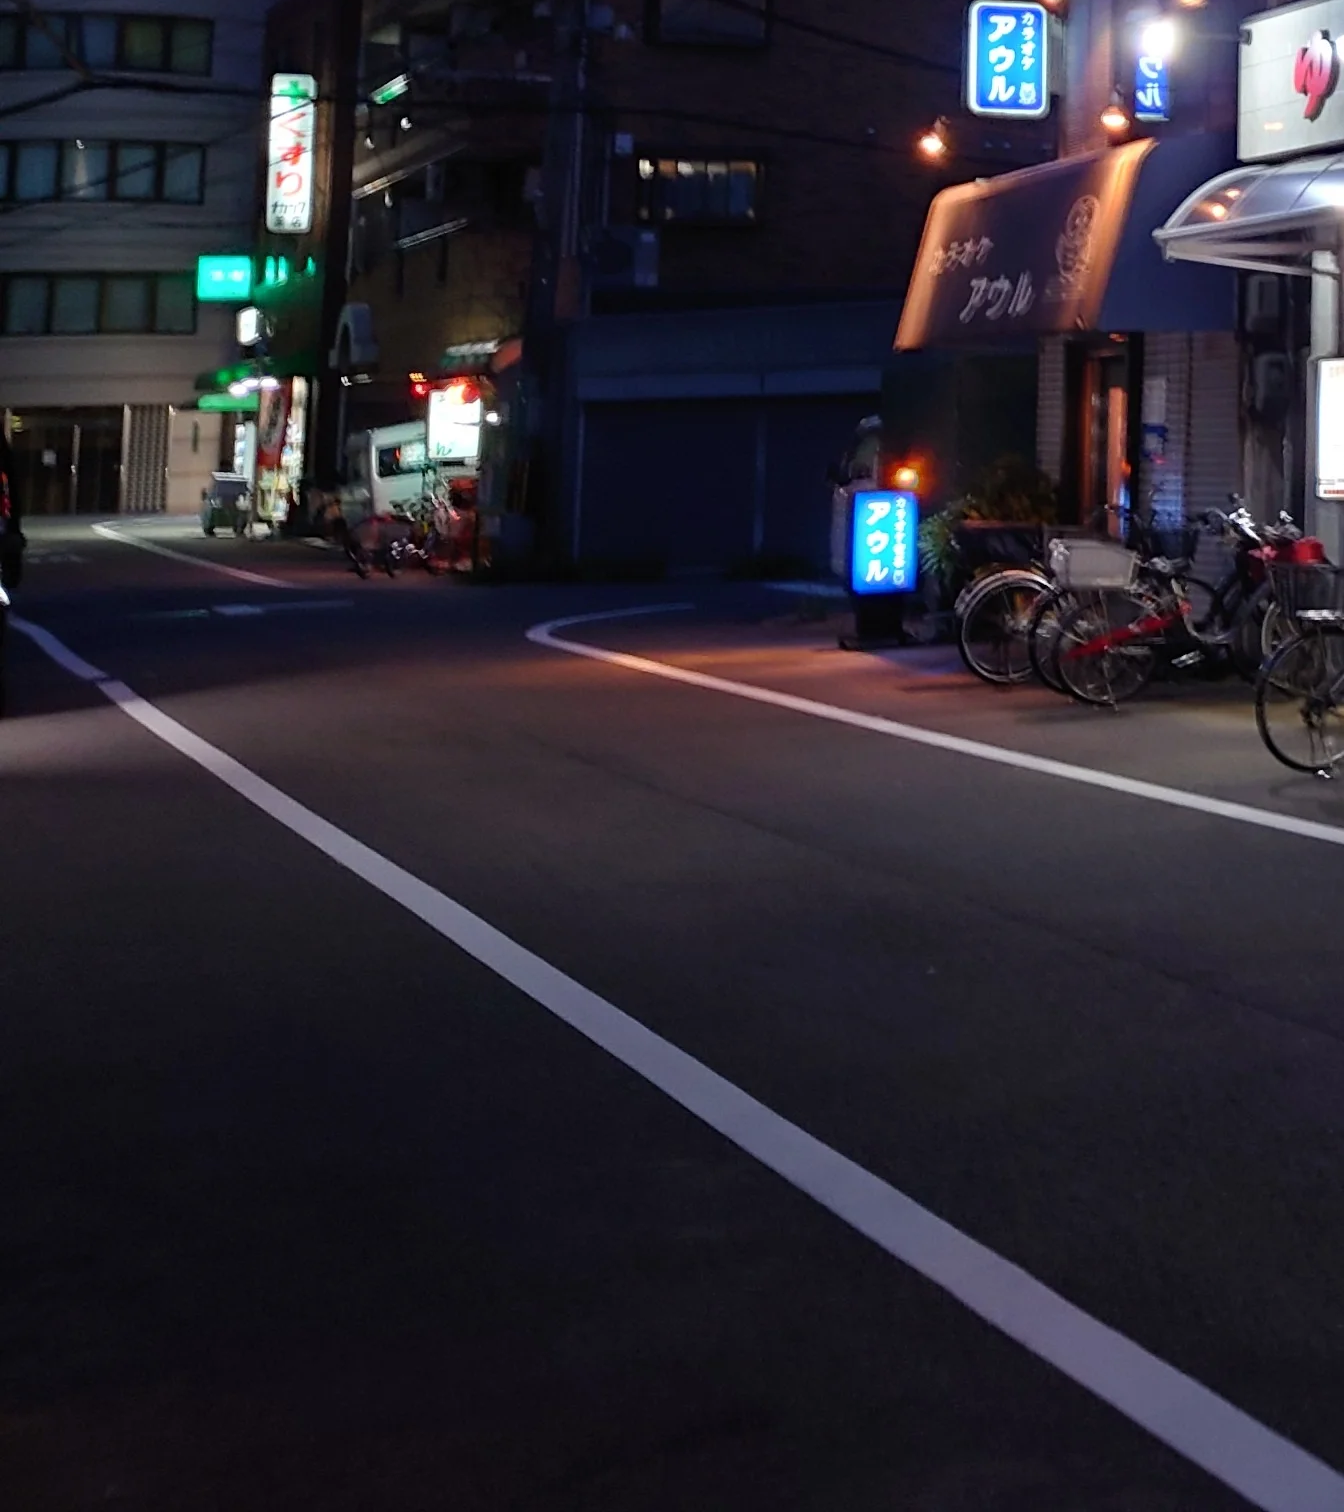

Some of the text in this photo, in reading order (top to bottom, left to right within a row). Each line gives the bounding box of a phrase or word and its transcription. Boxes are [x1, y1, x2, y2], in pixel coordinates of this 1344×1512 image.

[987, 14, 1017, 102] アウル
[1021, 12, 1036, 71] カラオケ
[275, 112, 307, 197] くすり
[959, 270, 1036, 324] アウル
[866, 501, 892, 582] アウル
